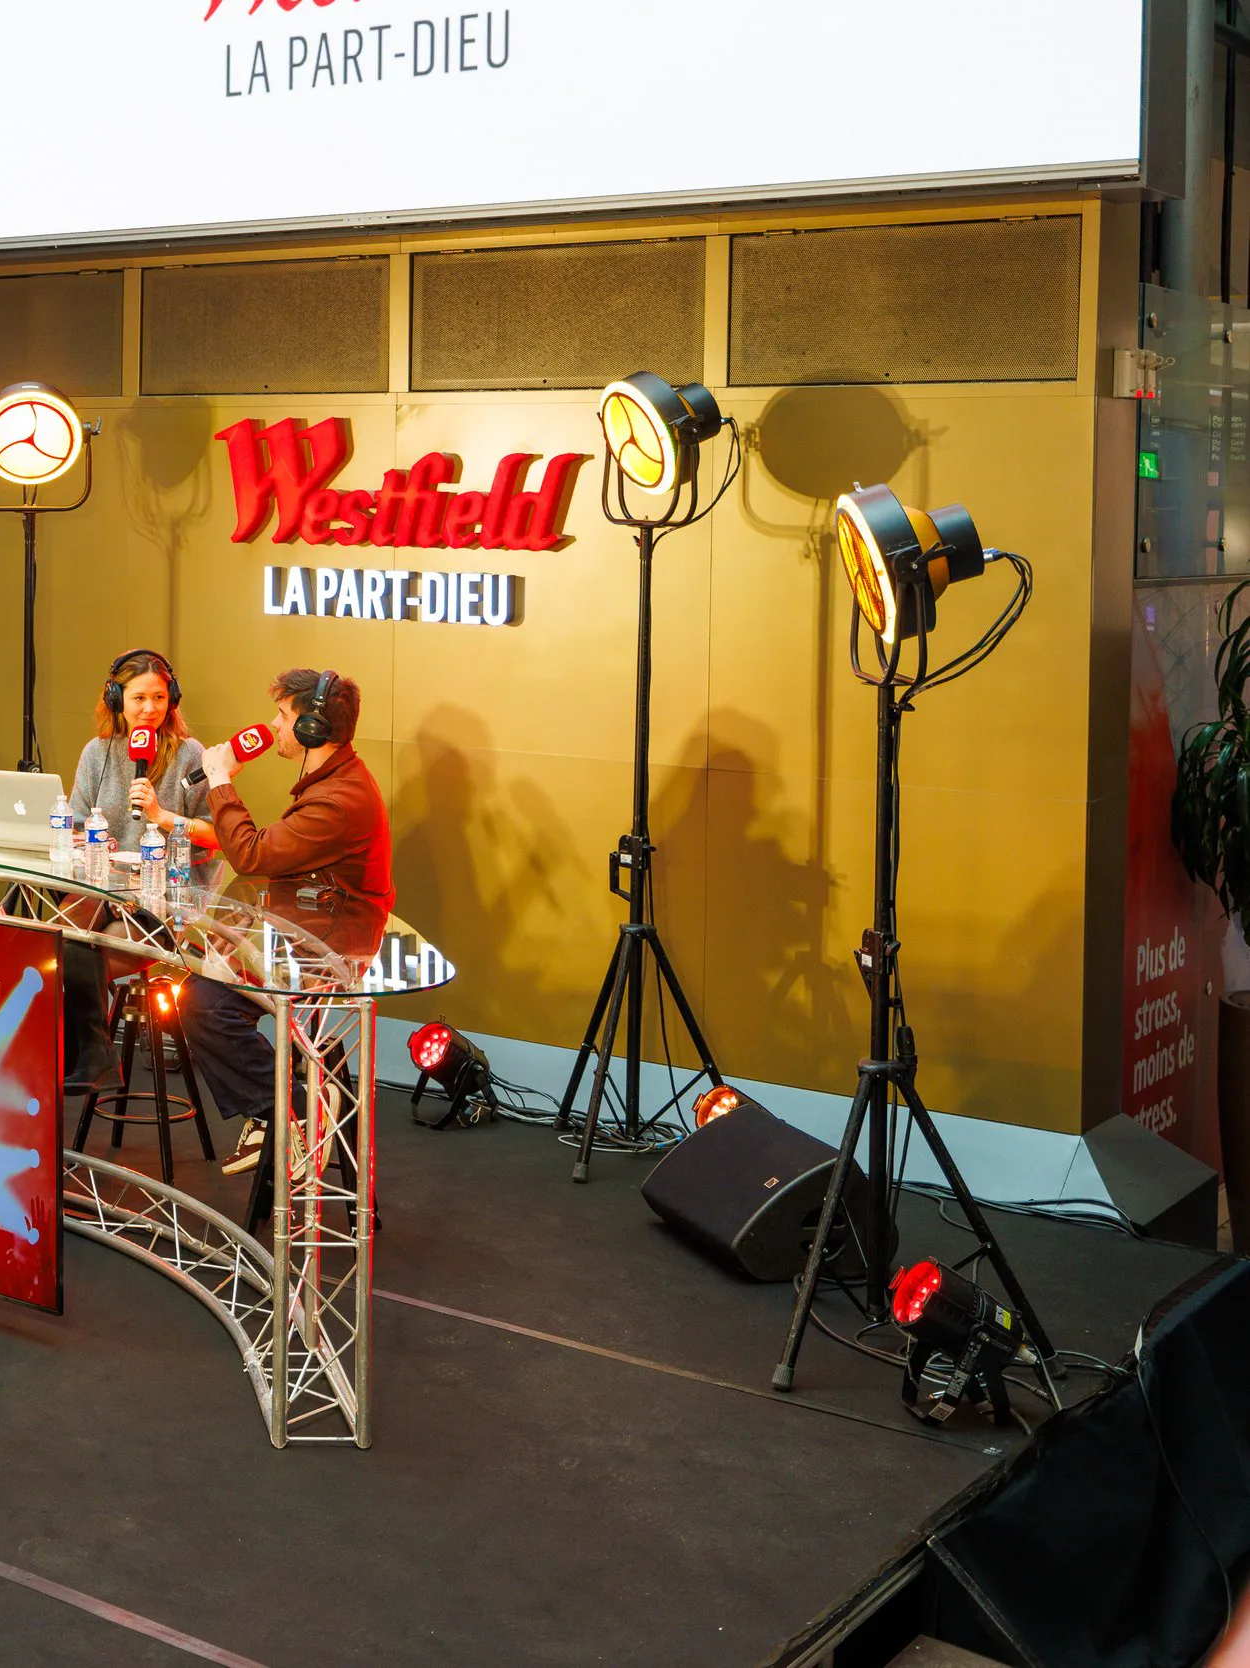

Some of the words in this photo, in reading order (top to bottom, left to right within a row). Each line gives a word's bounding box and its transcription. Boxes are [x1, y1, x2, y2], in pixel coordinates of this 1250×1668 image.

[226, 41, 270, 97] LA
[289, 10, 510, 90] PART-DIEU
[215, 417, 586, 550] Westfield
[264, 565, 308, 616] LA
[317, 567, 509, 627] PART-DIEU
[1136, 938, 1165, 986] Plus
[1169, 926, 1186, 971] de
[1134, 990, 1181, 1040] strass,
[1133, 1040, 1175, 1094] moins
[1178, 1024, 1195, 1071] de
